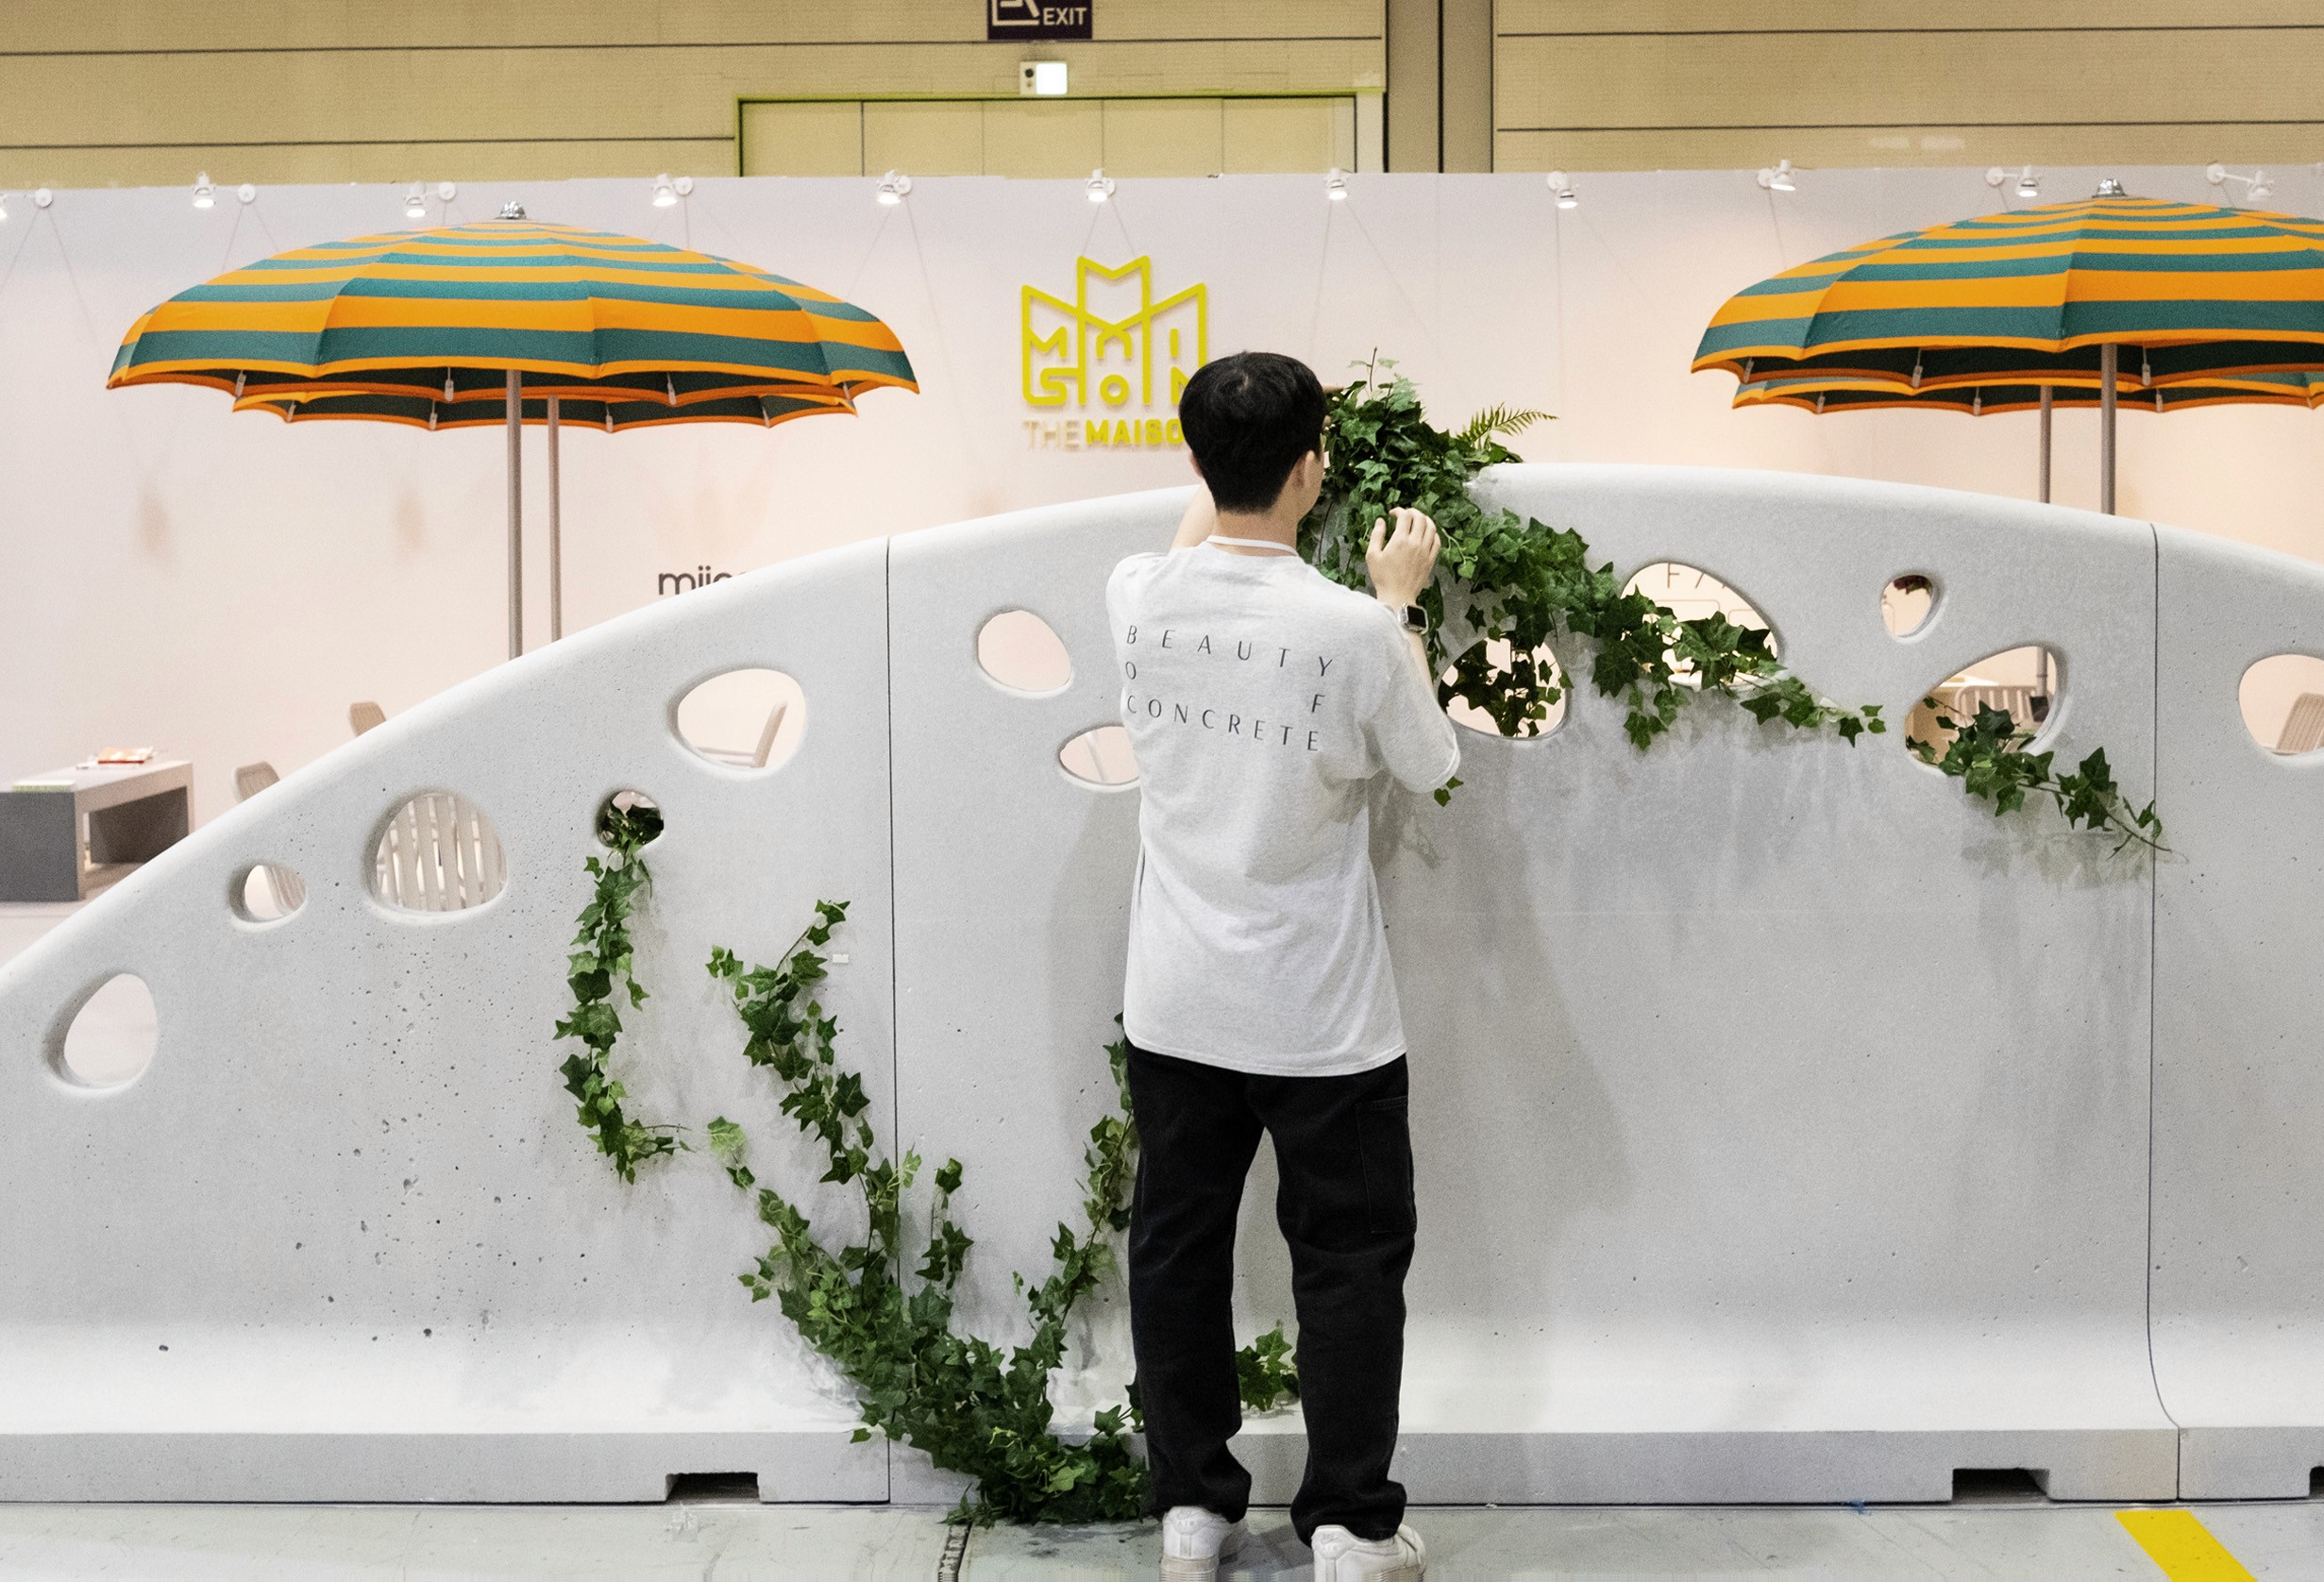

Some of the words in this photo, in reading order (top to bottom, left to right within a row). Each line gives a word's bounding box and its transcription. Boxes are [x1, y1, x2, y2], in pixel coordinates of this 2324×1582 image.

[1043, 8, 1087, 25] EXIT
[1022, 419, 1081, 449] THE
[1086, 418, 1185, 445] MAISO
[1126, 625, 1333, 677] BEAUTY
[1127, 695, 1320, 751] CONCRETE
